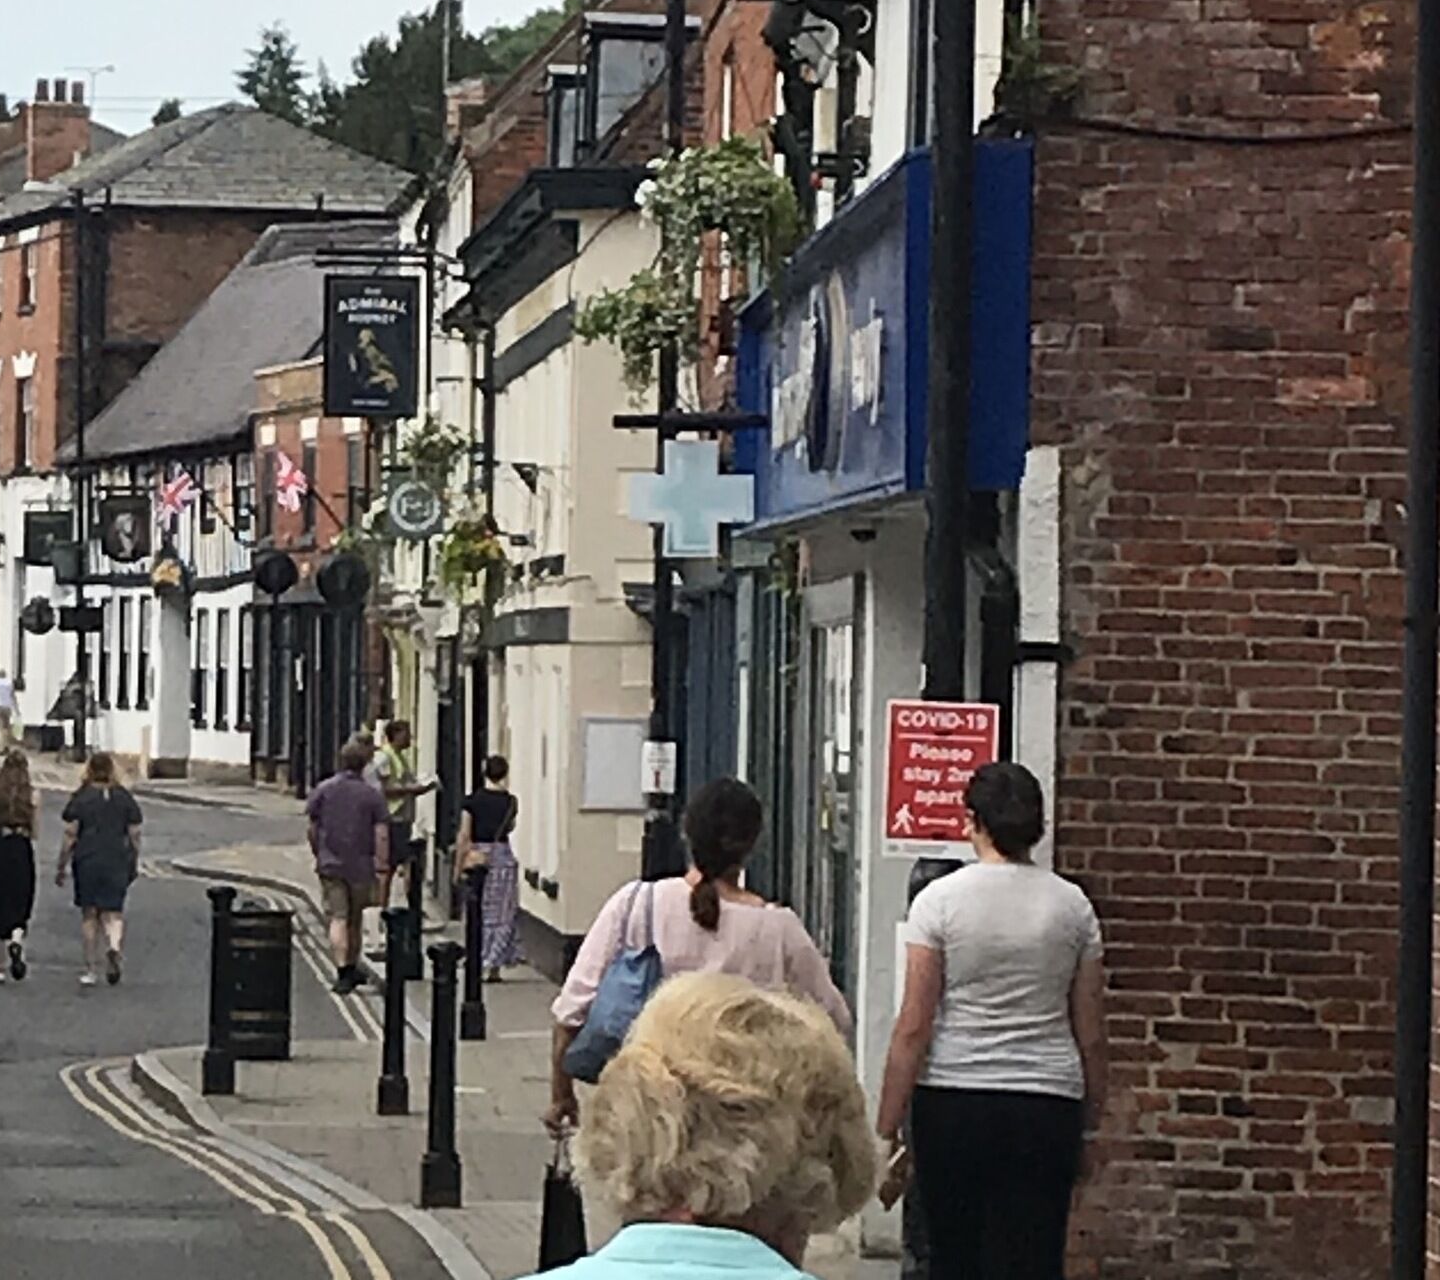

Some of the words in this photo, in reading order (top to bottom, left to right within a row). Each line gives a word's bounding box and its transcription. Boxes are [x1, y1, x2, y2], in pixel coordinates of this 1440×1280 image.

[337, 297, 408, 315] ADMIRAL
[897, 709, 989, 731] COVID-19
[909, 741, 974, 762] Please
[902, 767, 943, 786] stay
[914, 789, 965, 807] apart
